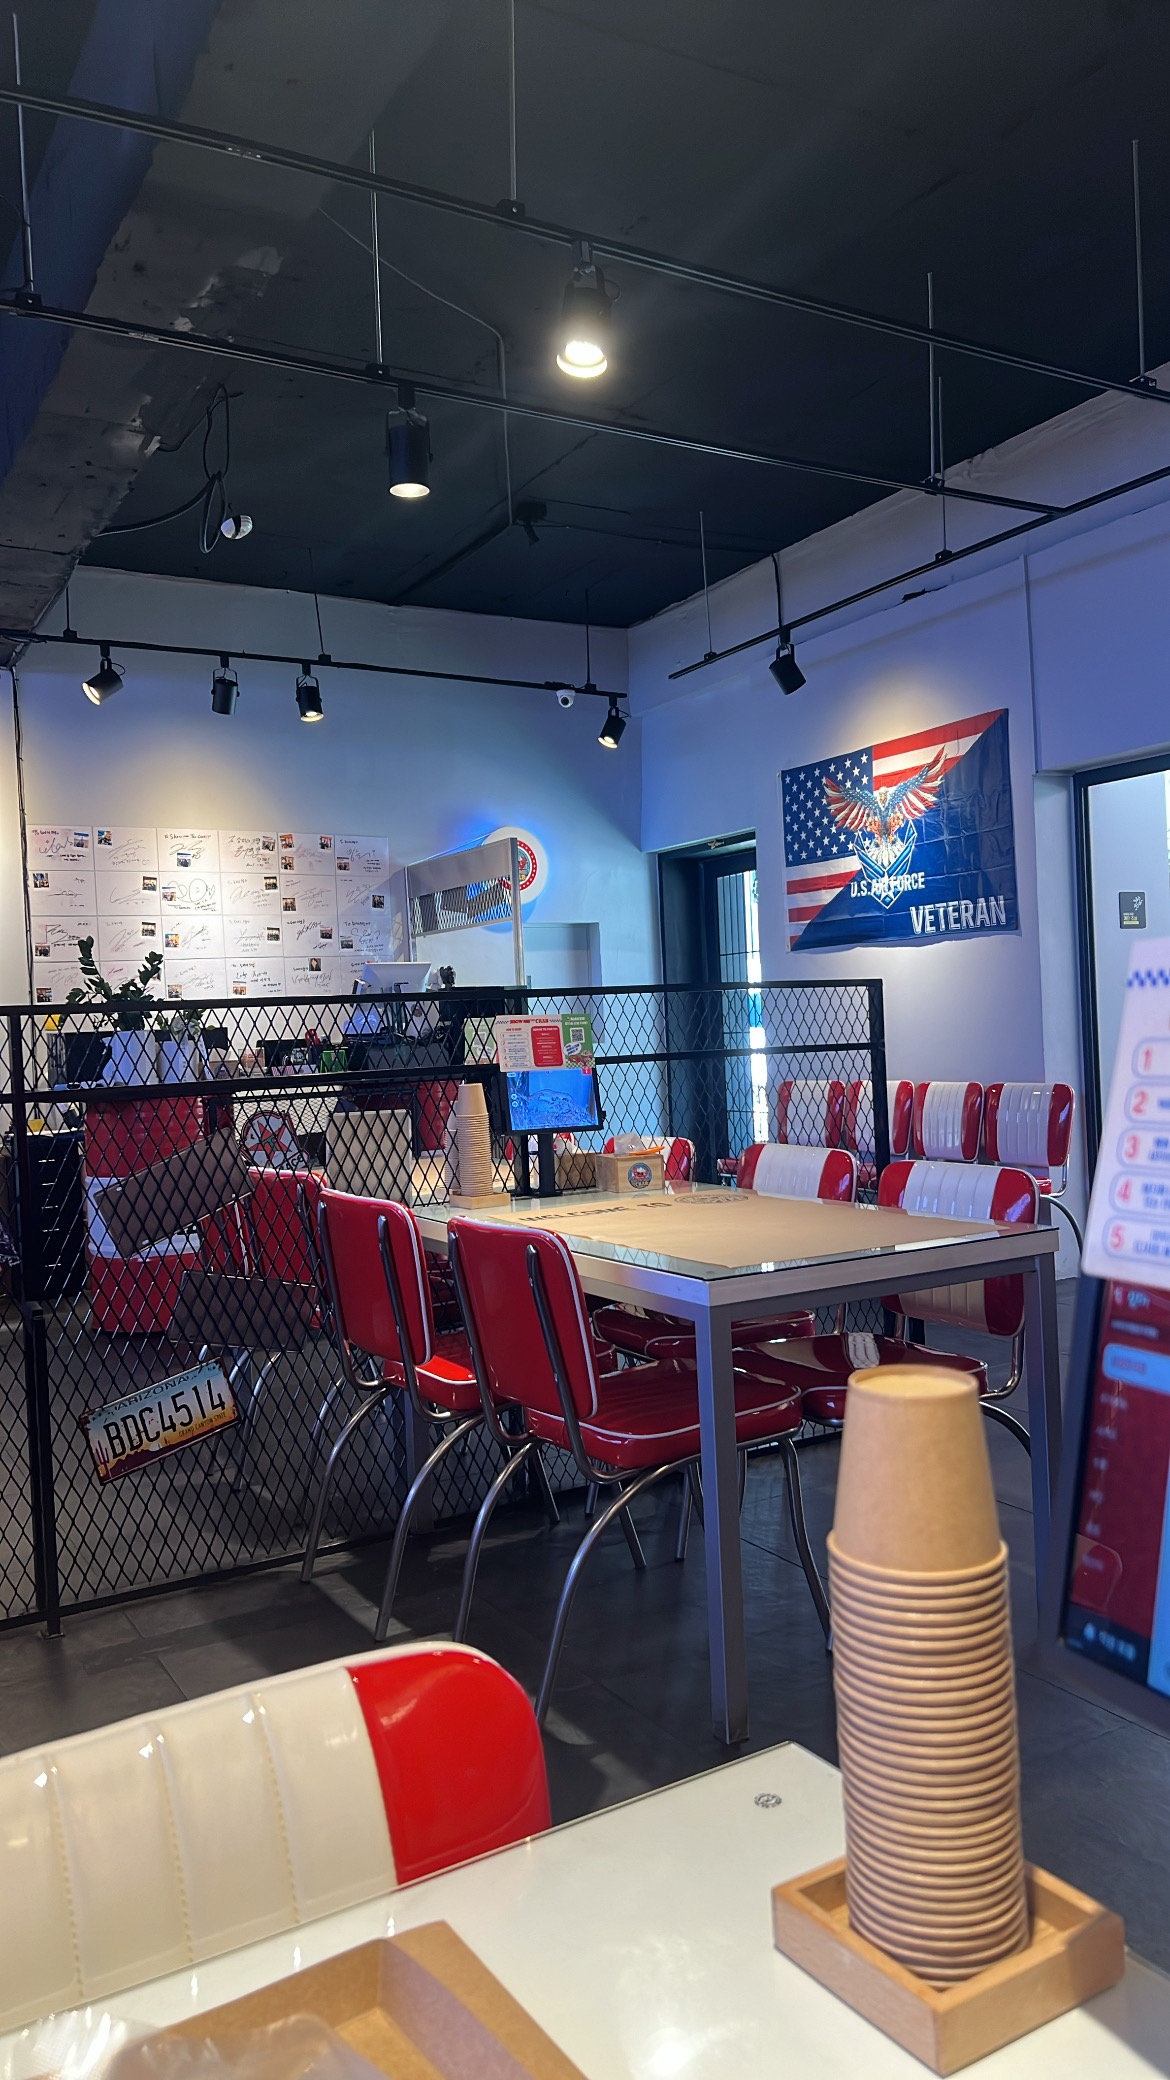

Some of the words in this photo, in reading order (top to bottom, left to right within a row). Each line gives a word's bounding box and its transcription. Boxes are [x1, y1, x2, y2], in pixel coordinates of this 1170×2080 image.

[850, 880, 871, 898] U.S.
[890, 872, 925, 893] FORCE
[909, 895, 1007, 935] VETERAN
[1142, 1048, 1153, 1070] 1
[1132, 1091, 1148, 1114] 2
[1124, 1136, 1139, 1159] 3
[1117, 1181, 1132, 1203] 4
[519, 1205, 636, 1222] WELCOME
[1110, 1225, 1124, 1250] 5
[116, 1374, 188, 1411] ARIZONA
[103, 1379, 226, 1459] BDC4514
[195, 1417, 213, 1430] CANYON
